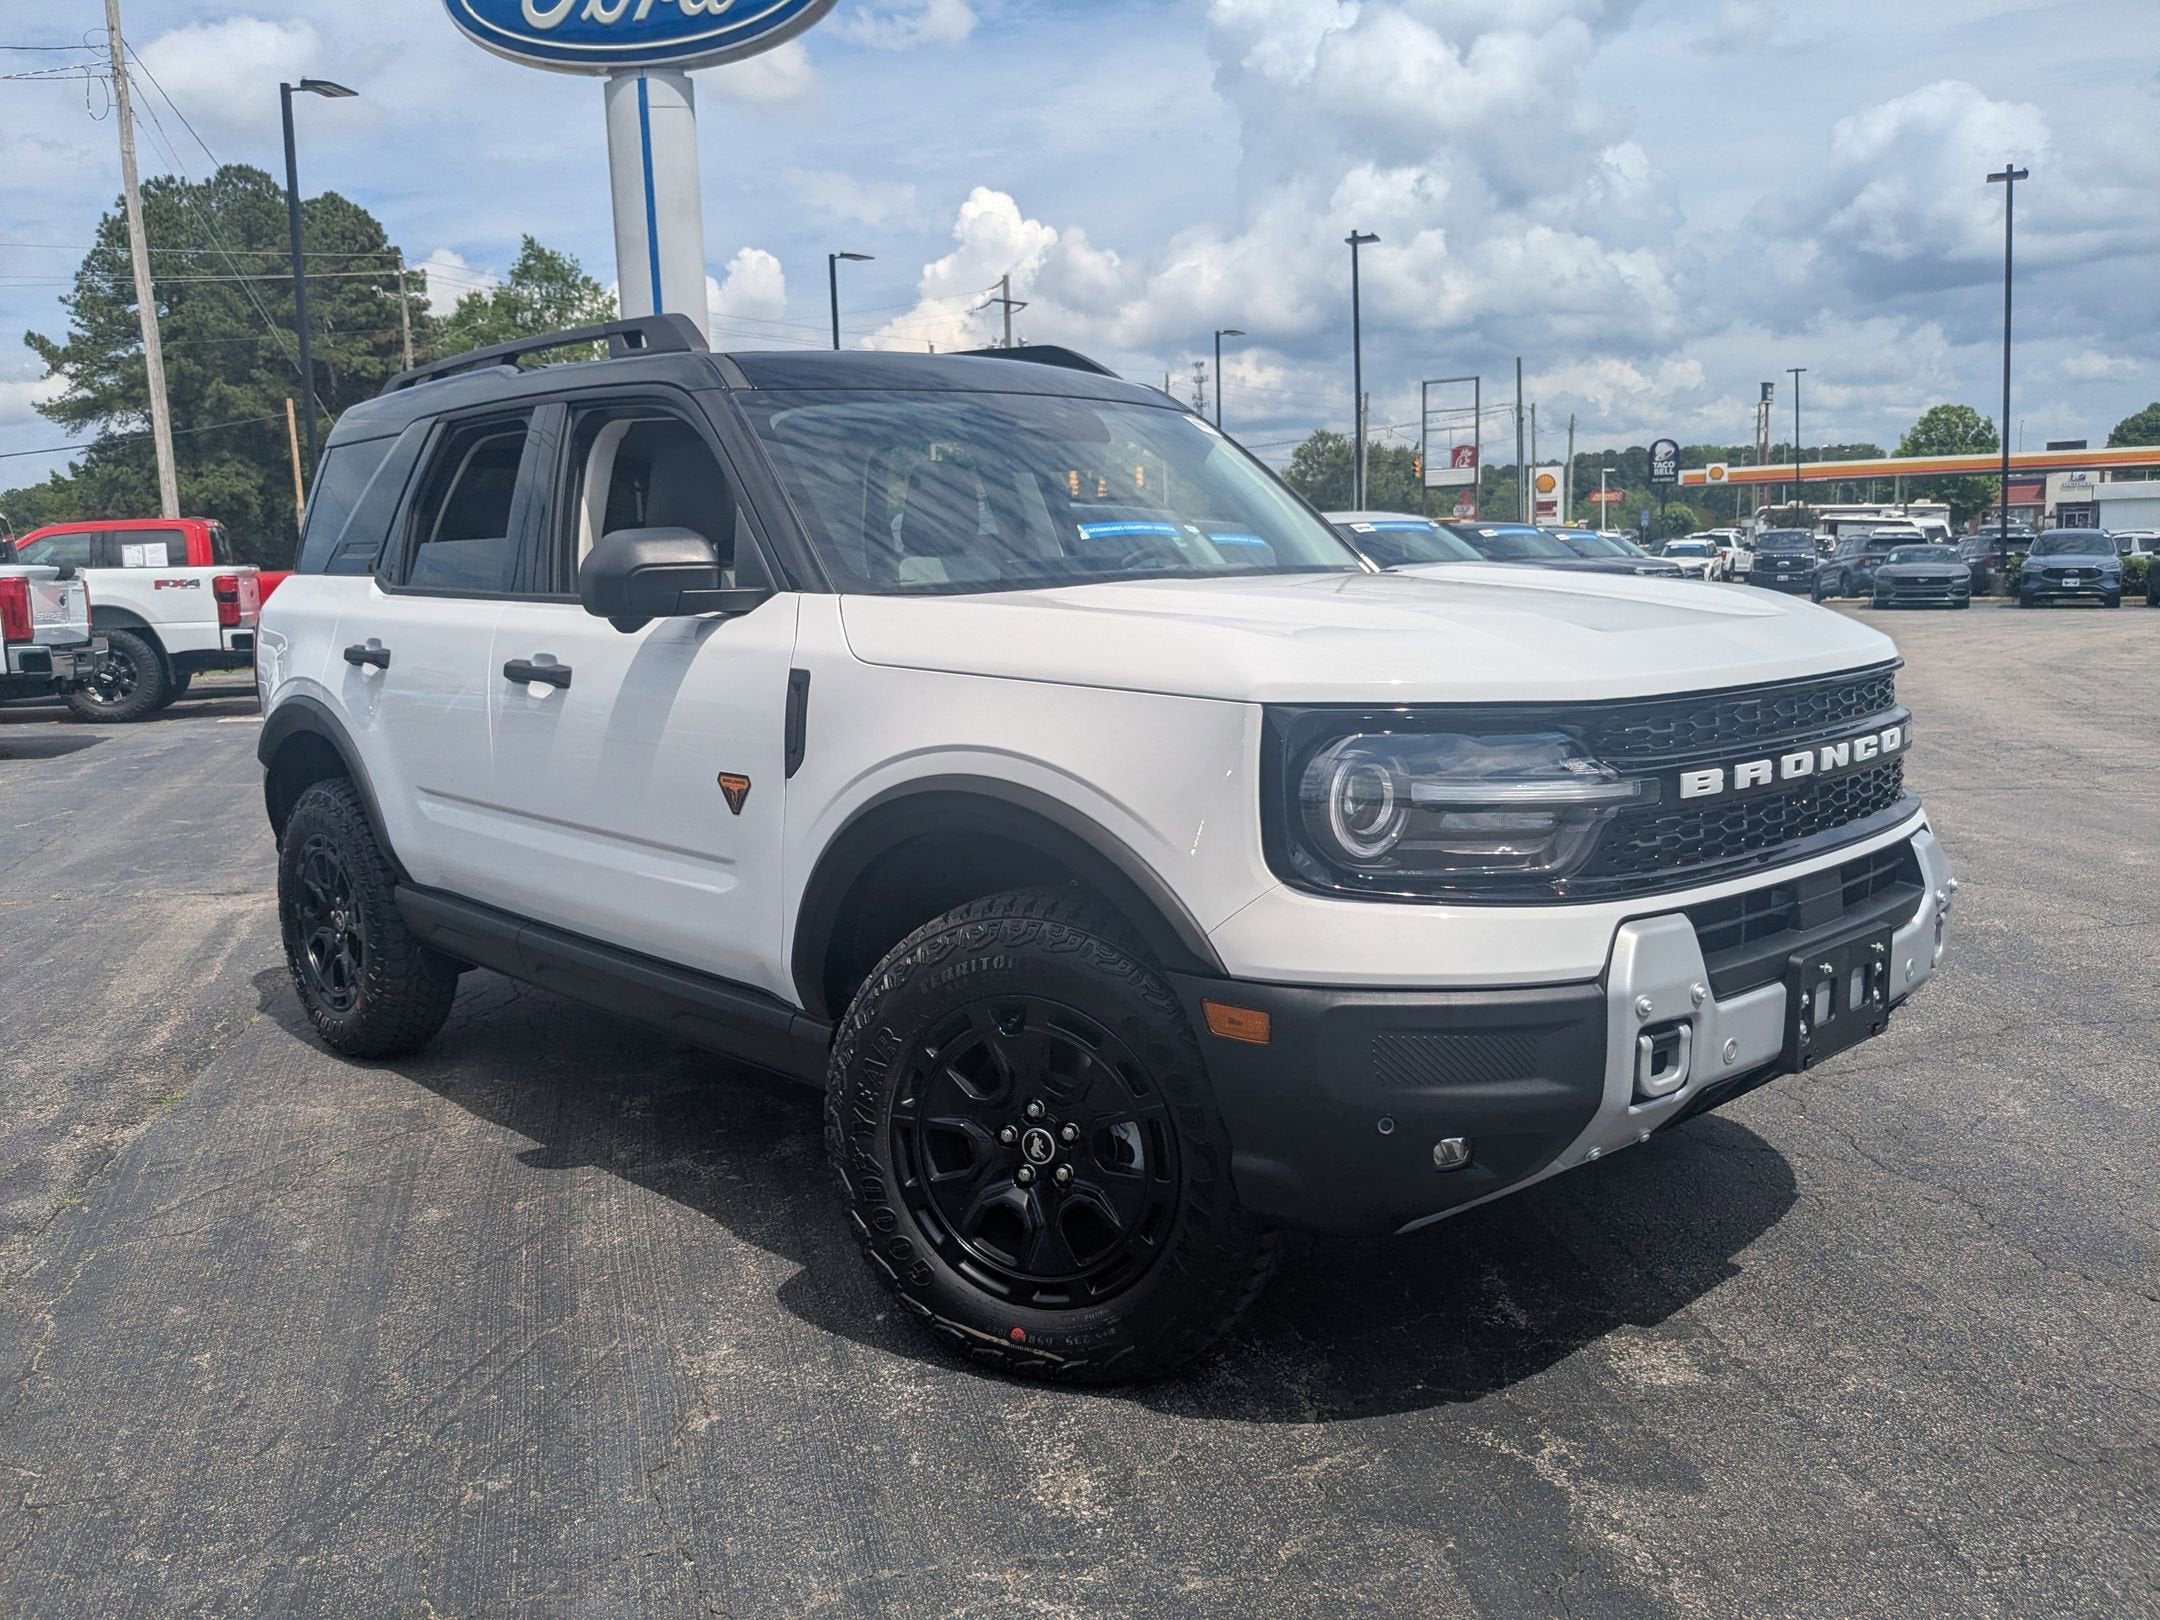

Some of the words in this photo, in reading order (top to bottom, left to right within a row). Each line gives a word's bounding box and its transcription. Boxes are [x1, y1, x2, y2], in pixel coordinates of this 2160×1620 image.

[1652, 461, 1675, 469] TACO
[154, 579, 200, 590] FX4
[1680, 727, 1901, 799] BRONCO
[849, 1026, 935, 1287] GOODYEAR
